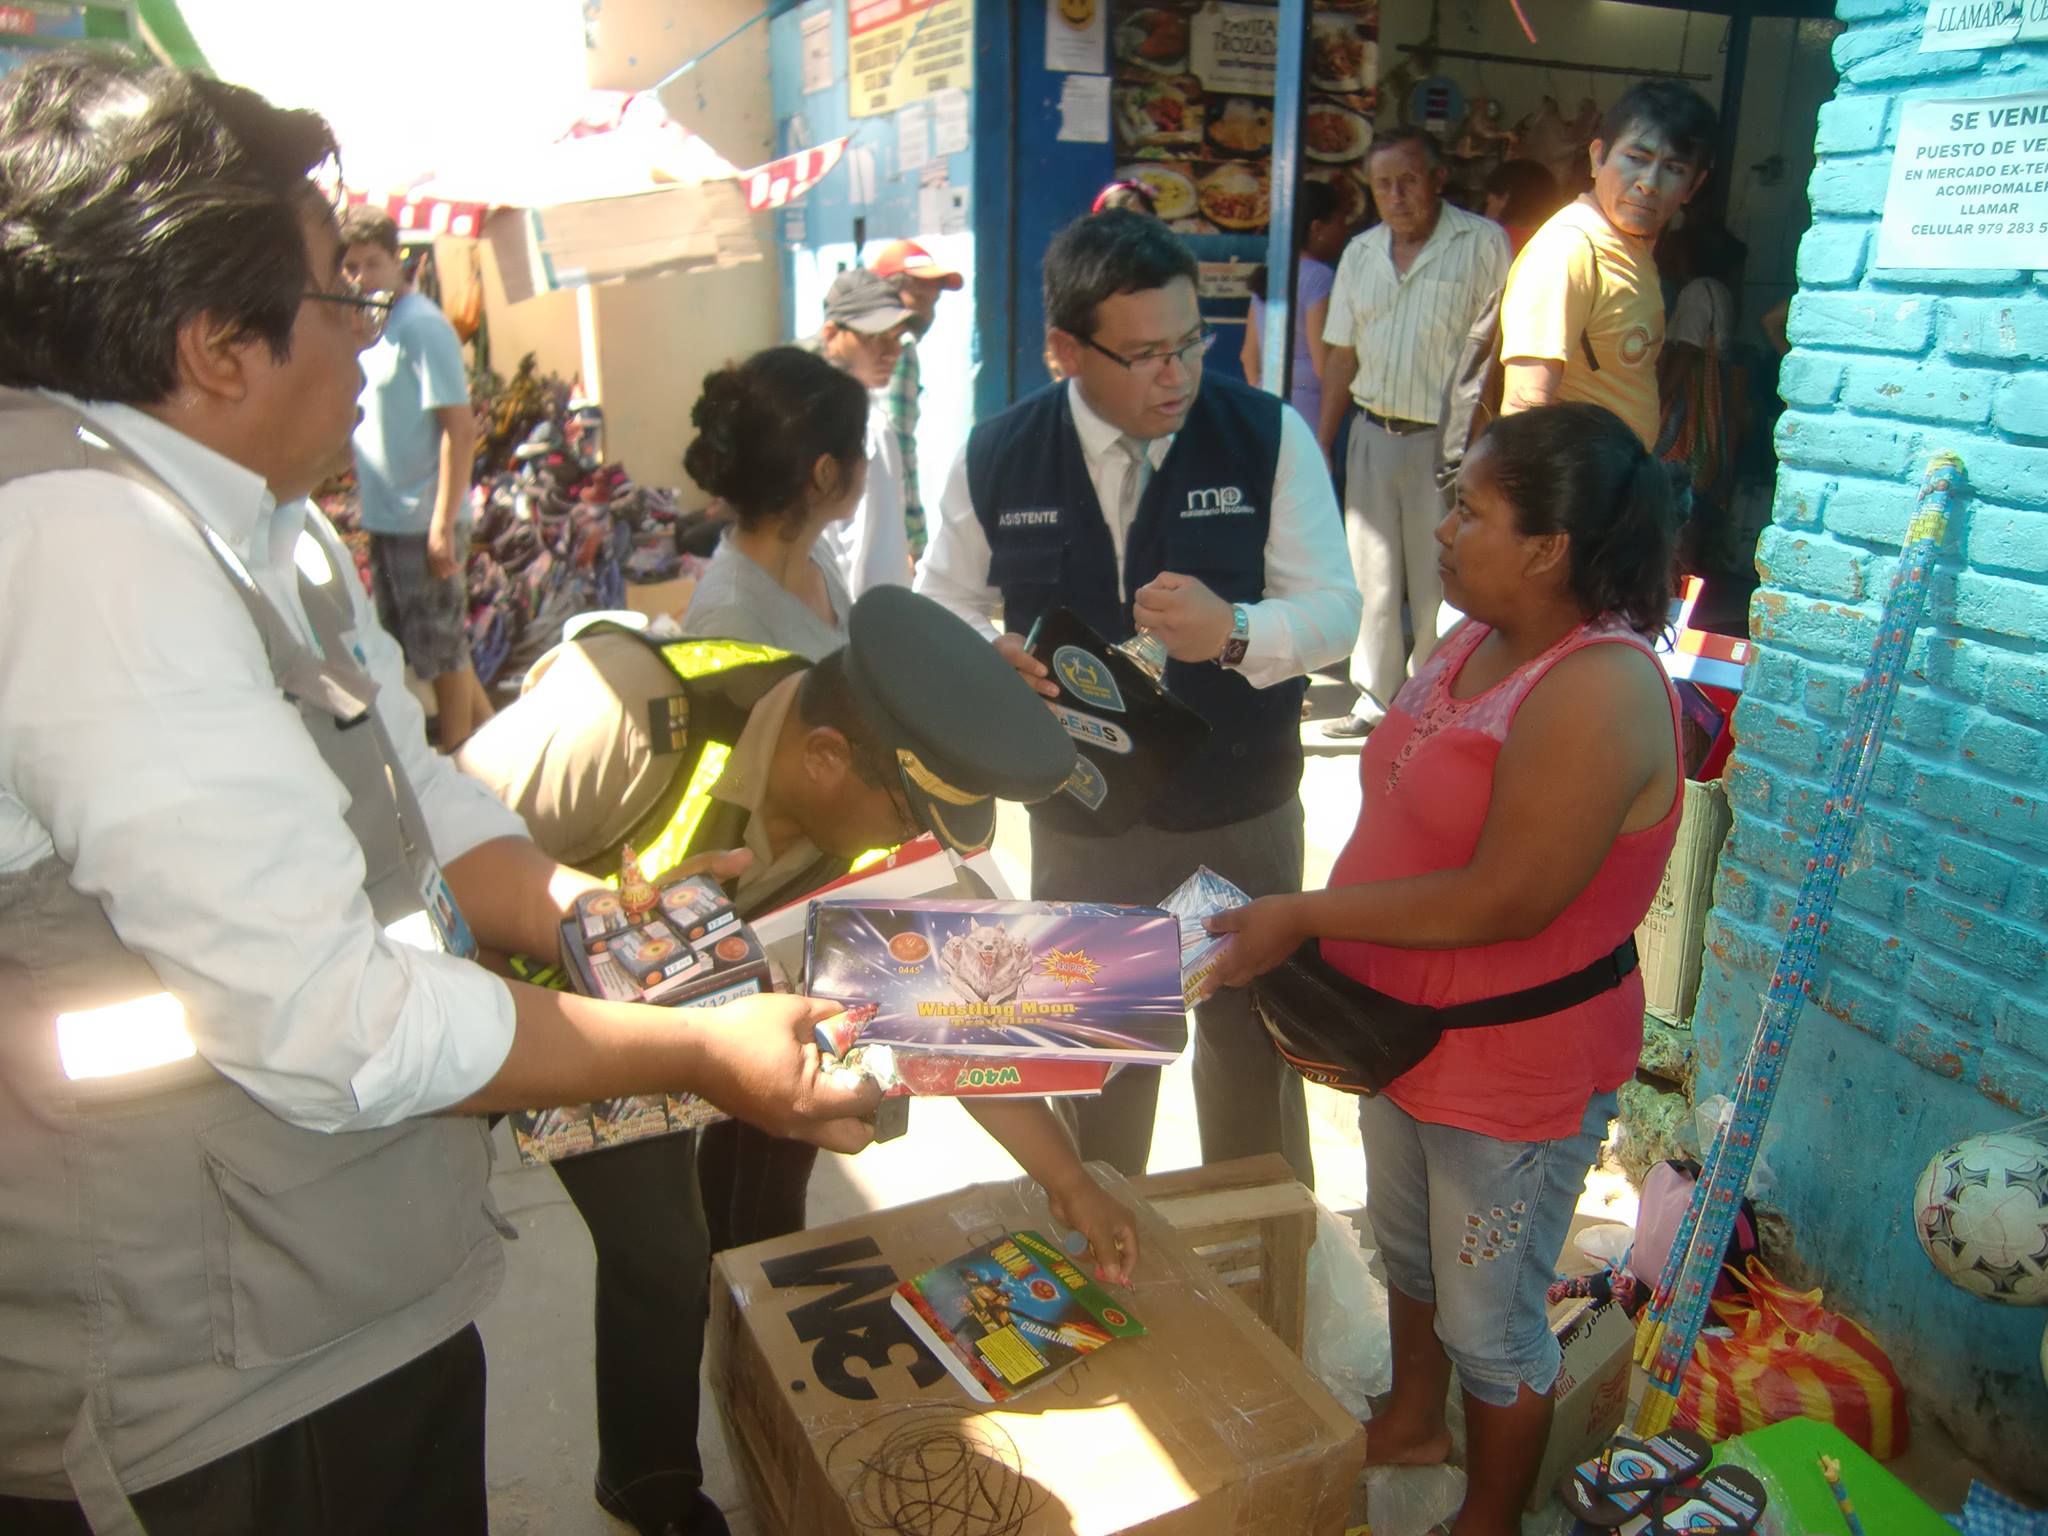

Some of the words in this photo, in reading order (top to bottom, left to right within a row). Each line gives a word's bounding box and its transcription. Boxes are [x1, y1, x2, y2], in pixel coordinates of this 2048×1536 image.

[1938, 0, 2003, 32] LLAMAR
[1950, 111, 1980, 131] SE
[1916, 142, 1985, 159] PUESTO
[1991, 140, 2017, 155] DE
[2023, 138, 2048, 153] VE
[1905, 170, 1923, 181] EN
[1926, 165, 1996, 179] MERCADO
[1960, 203, 2019, 215] LLAMAR
[1911, 224, 1974, 235] CELULAR
[1978, 223, 2004, 234] 979
[2007, 222, 2034, 234] 283
[999, 511, 1058, 526] ASISTENTE
[917, 1001, 1015, 1017] Whistling
[1021, 1001, 1077, 1015] Moon
[760, 1236, 949, 1400] 3M
[1020, 1320, 1077, 1348] CRACKLING
